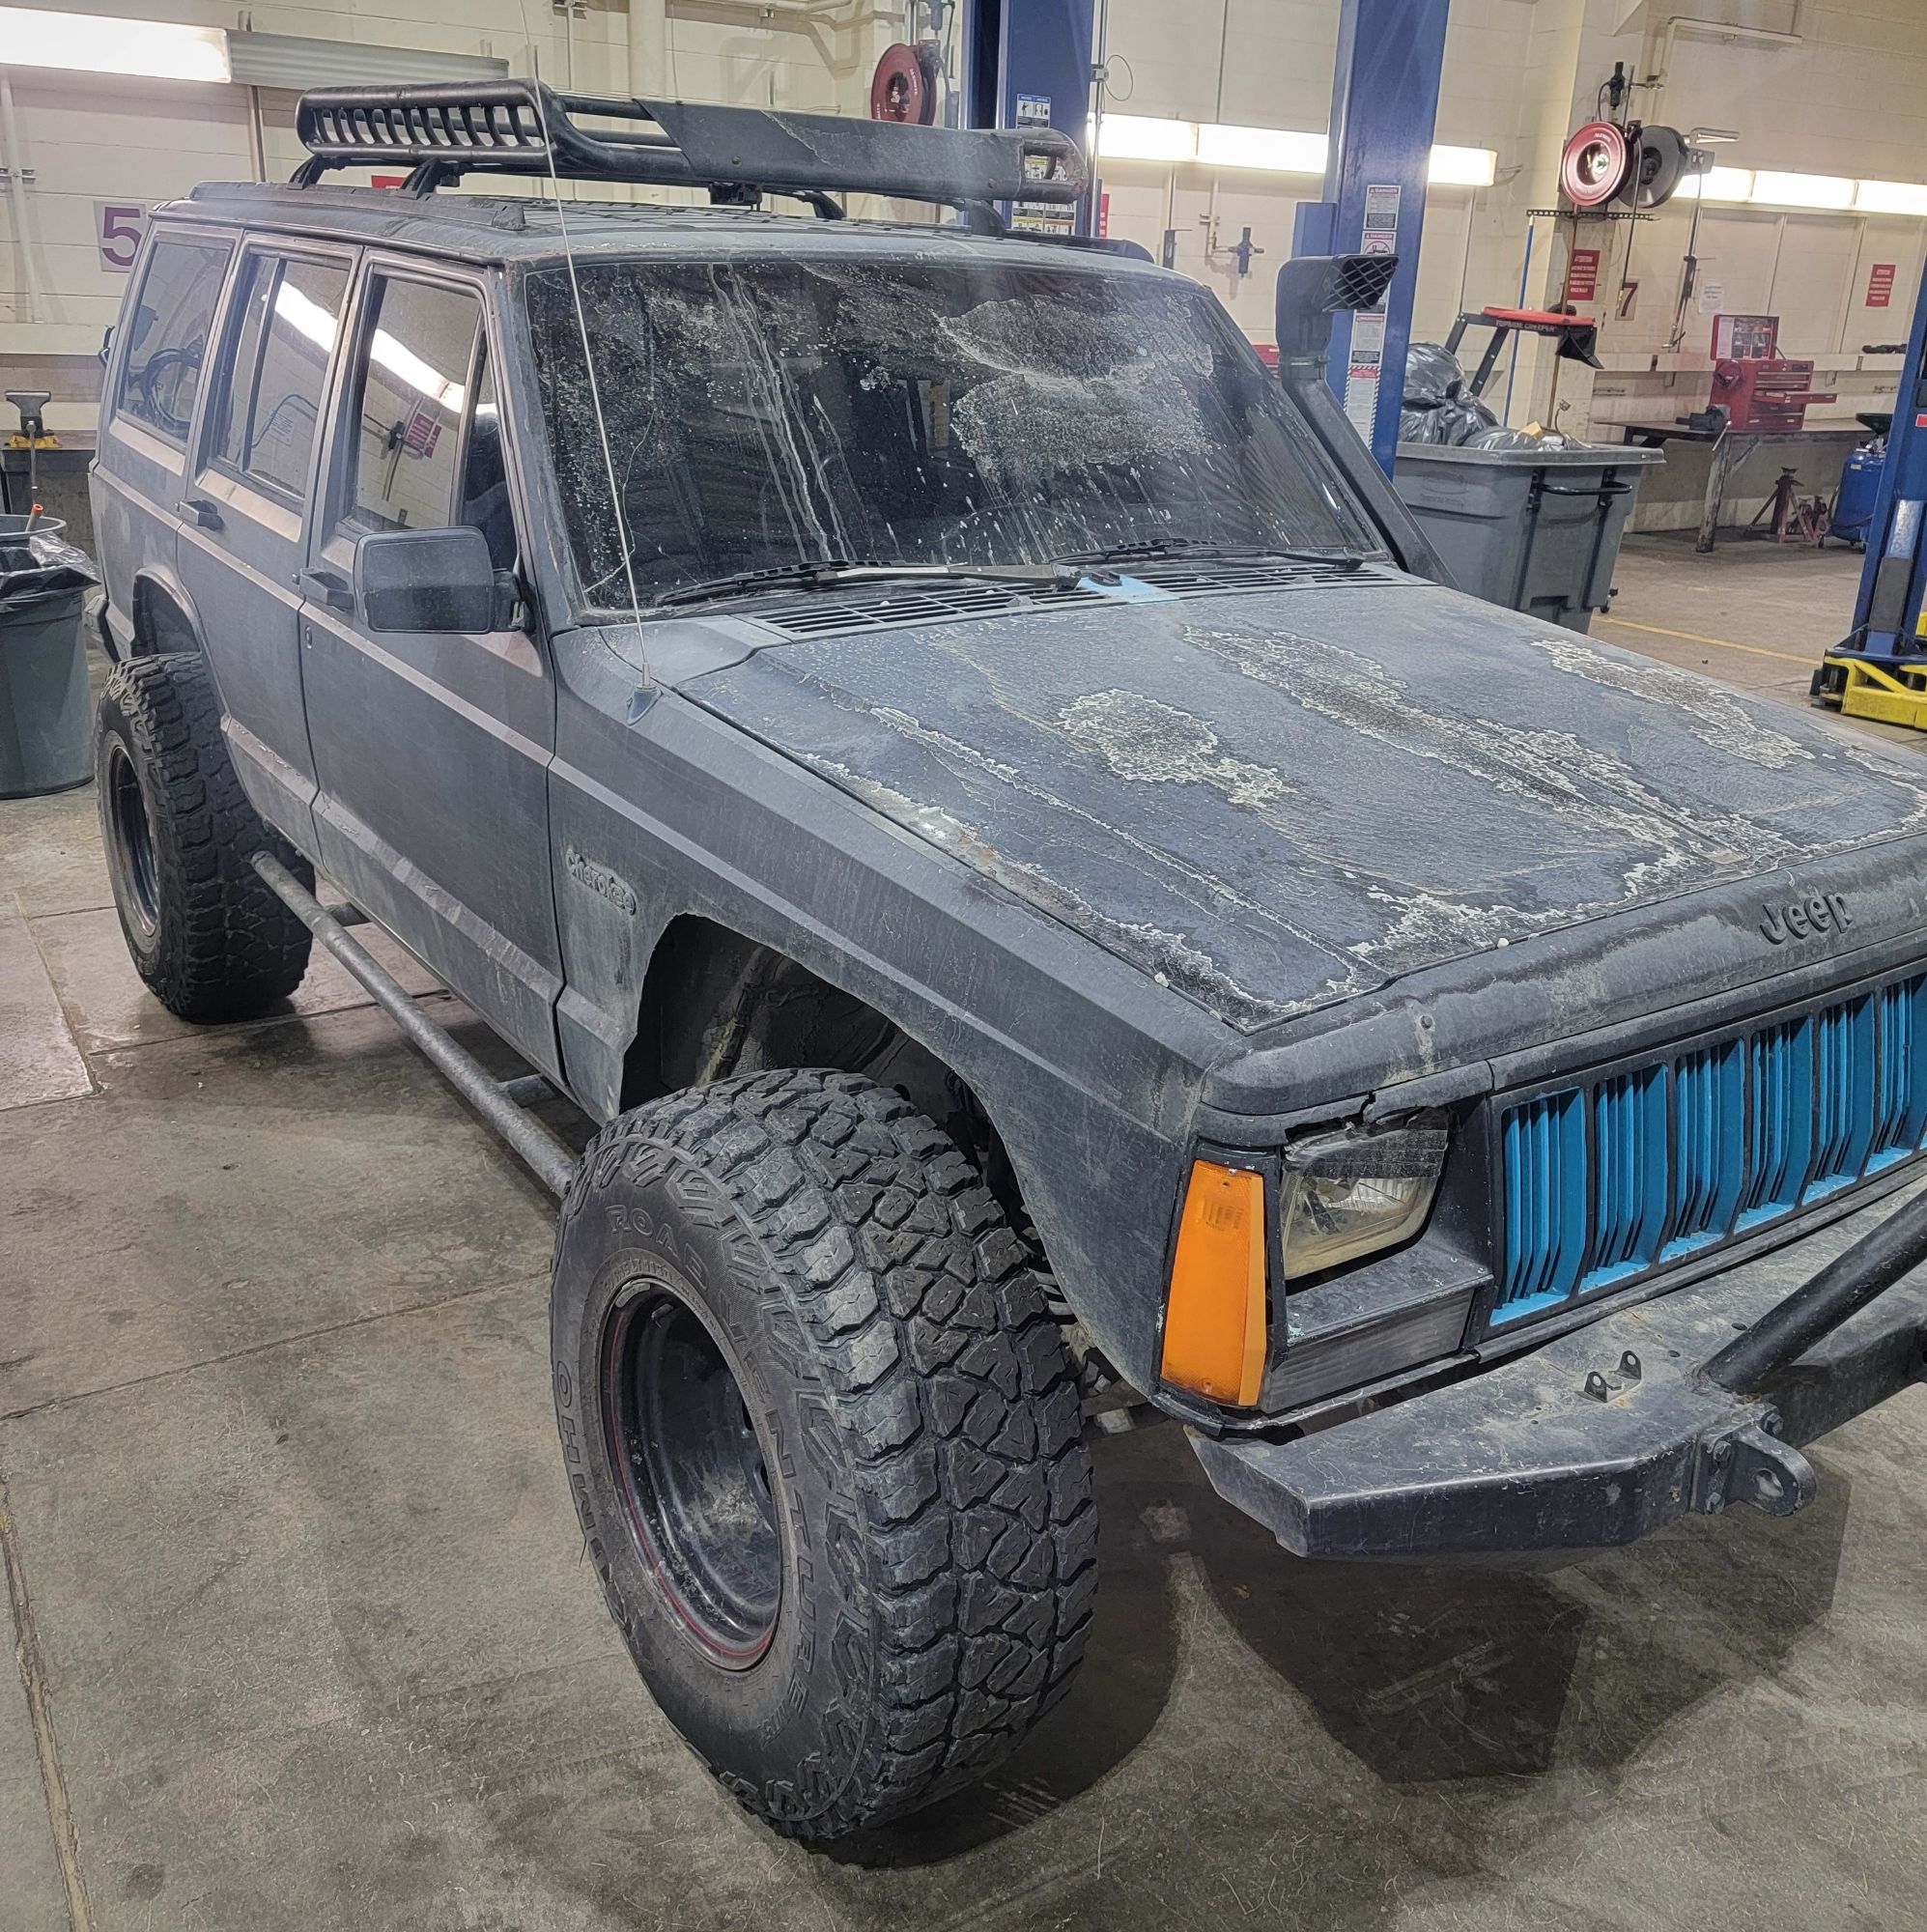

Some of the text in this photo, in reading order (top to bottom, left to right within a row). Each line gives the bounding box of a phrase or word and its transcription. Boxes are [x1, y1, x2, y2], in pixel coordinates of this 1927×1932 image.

[101, 206, 142, 267] 5
[1621, 282, 1639, 318] 7
[1759, 895, 1854, 946] Jeep
[604, 1204, 711, 1293] ROAD
